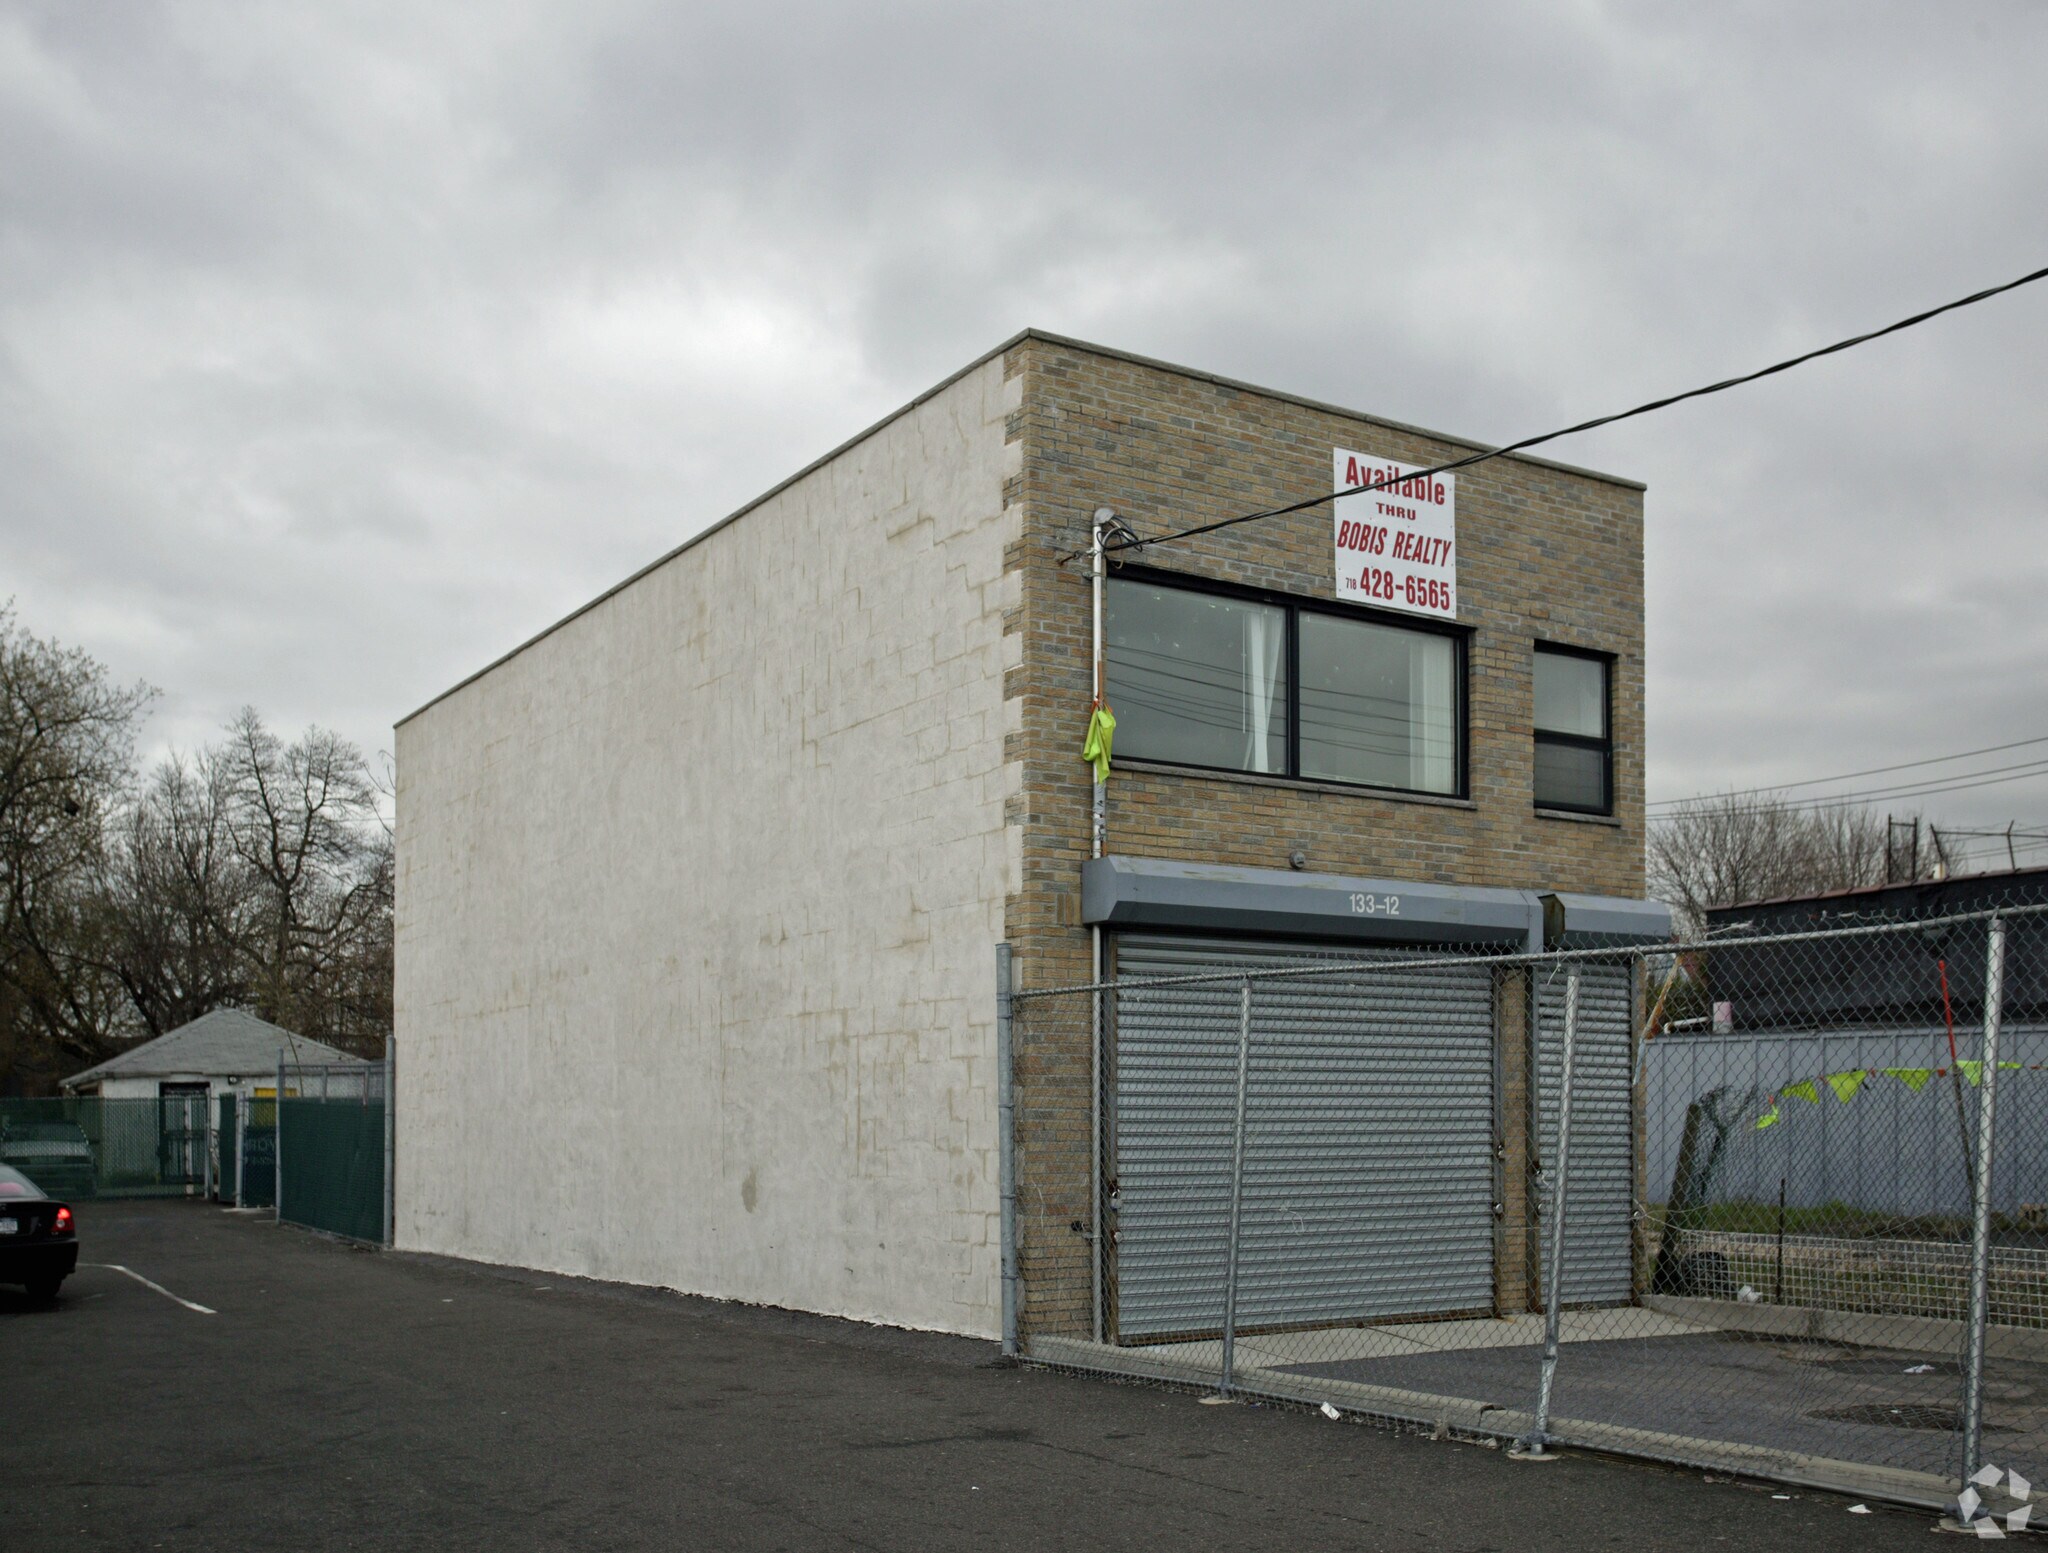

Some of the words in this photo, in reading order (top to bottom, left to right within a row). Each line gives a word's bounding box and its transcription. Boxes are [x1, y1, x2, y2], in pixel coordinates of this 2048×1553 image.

[1345, 456, 1445, 505] Available
[1375, 502, 1416, 521] THRU
[1337, 520, 1388, 556] BOBIS
[1392, 531, 1452, 567] REALTY
[1345, 577, 1357, 590] 718
[1360, 567, 1450, 611] 428-6565
[1349, 893, 1400, 915] 133-12
